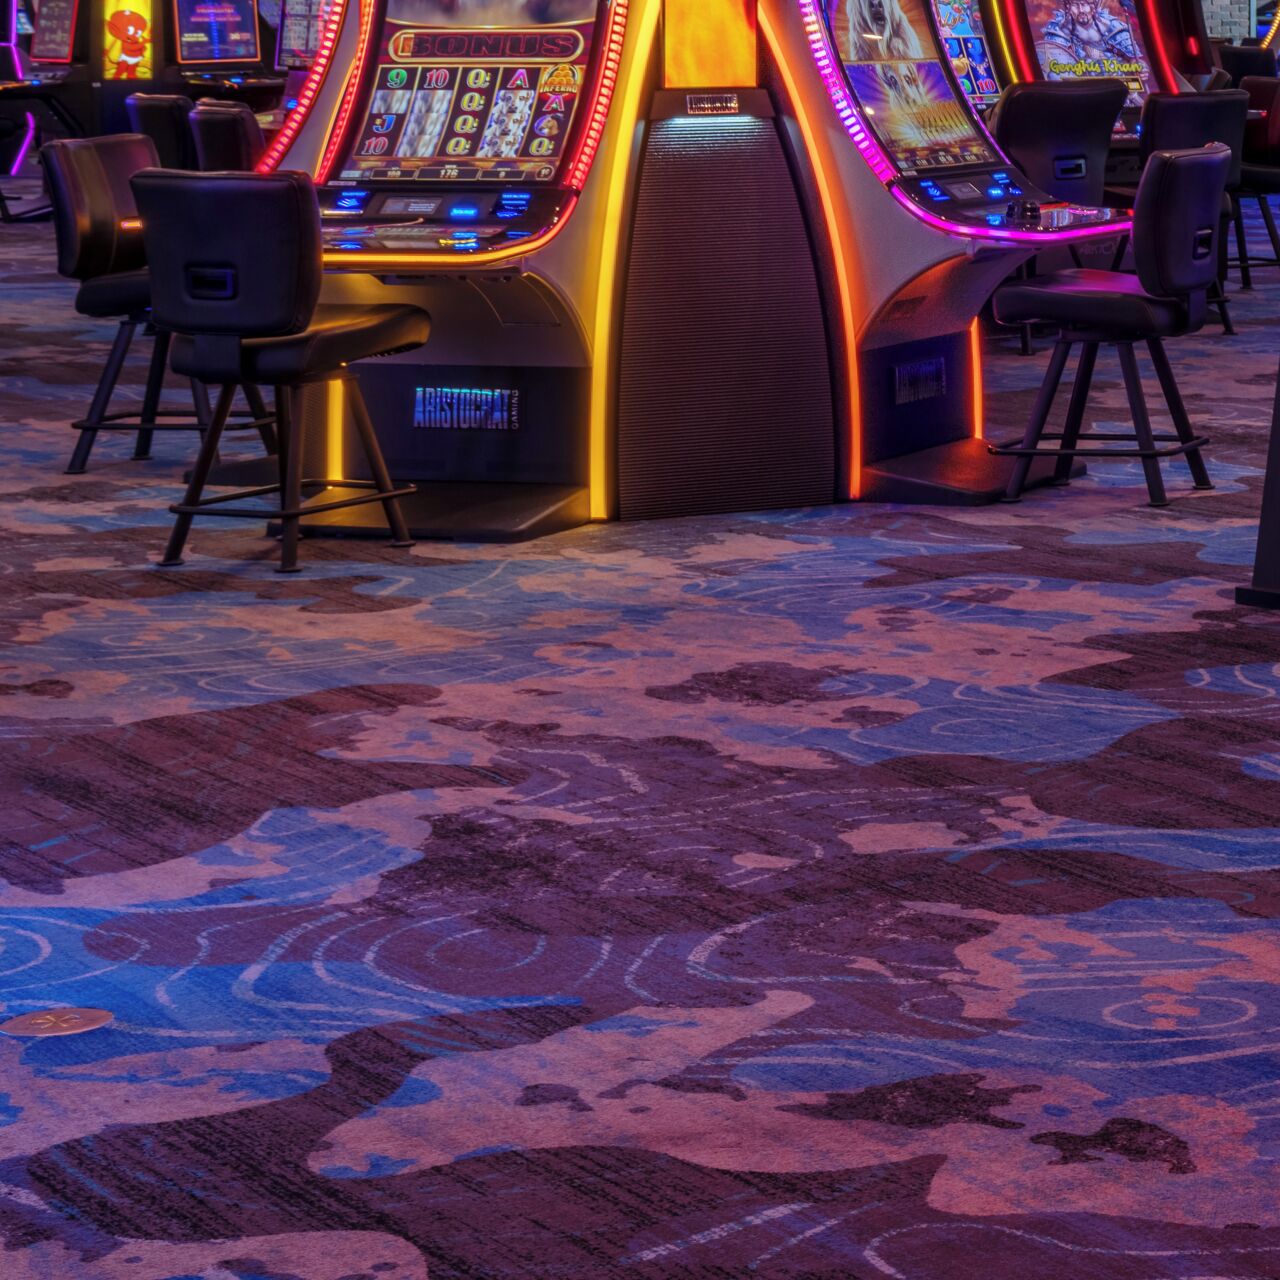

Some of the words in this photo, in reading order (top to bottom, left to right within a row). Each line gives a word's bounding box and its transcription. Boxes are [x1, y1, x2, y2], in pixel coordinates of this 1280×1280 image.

[398, 34, 575, 57] BONUS
[1050, 59, 1100, 75] Genghis
[1103, 59, 1143, 73] Khan
[386, 68, 408, 88] 9
[424, 68, 450, 88] 10
[466, 68, 491, 89] Q
[507, 68, 529, 88] A
[460, 91, 485, 112] Q
[542, 94, 565, 112] A
[373, 114, 397, 133] J
[454, 114, 479, 134] Q
[362, 136, 389, 155] 10
[446, 136, 471, 156] Q
[529, 136, 555, 156] Q
[413, 387, 511, 430] ARISTOCRAT
